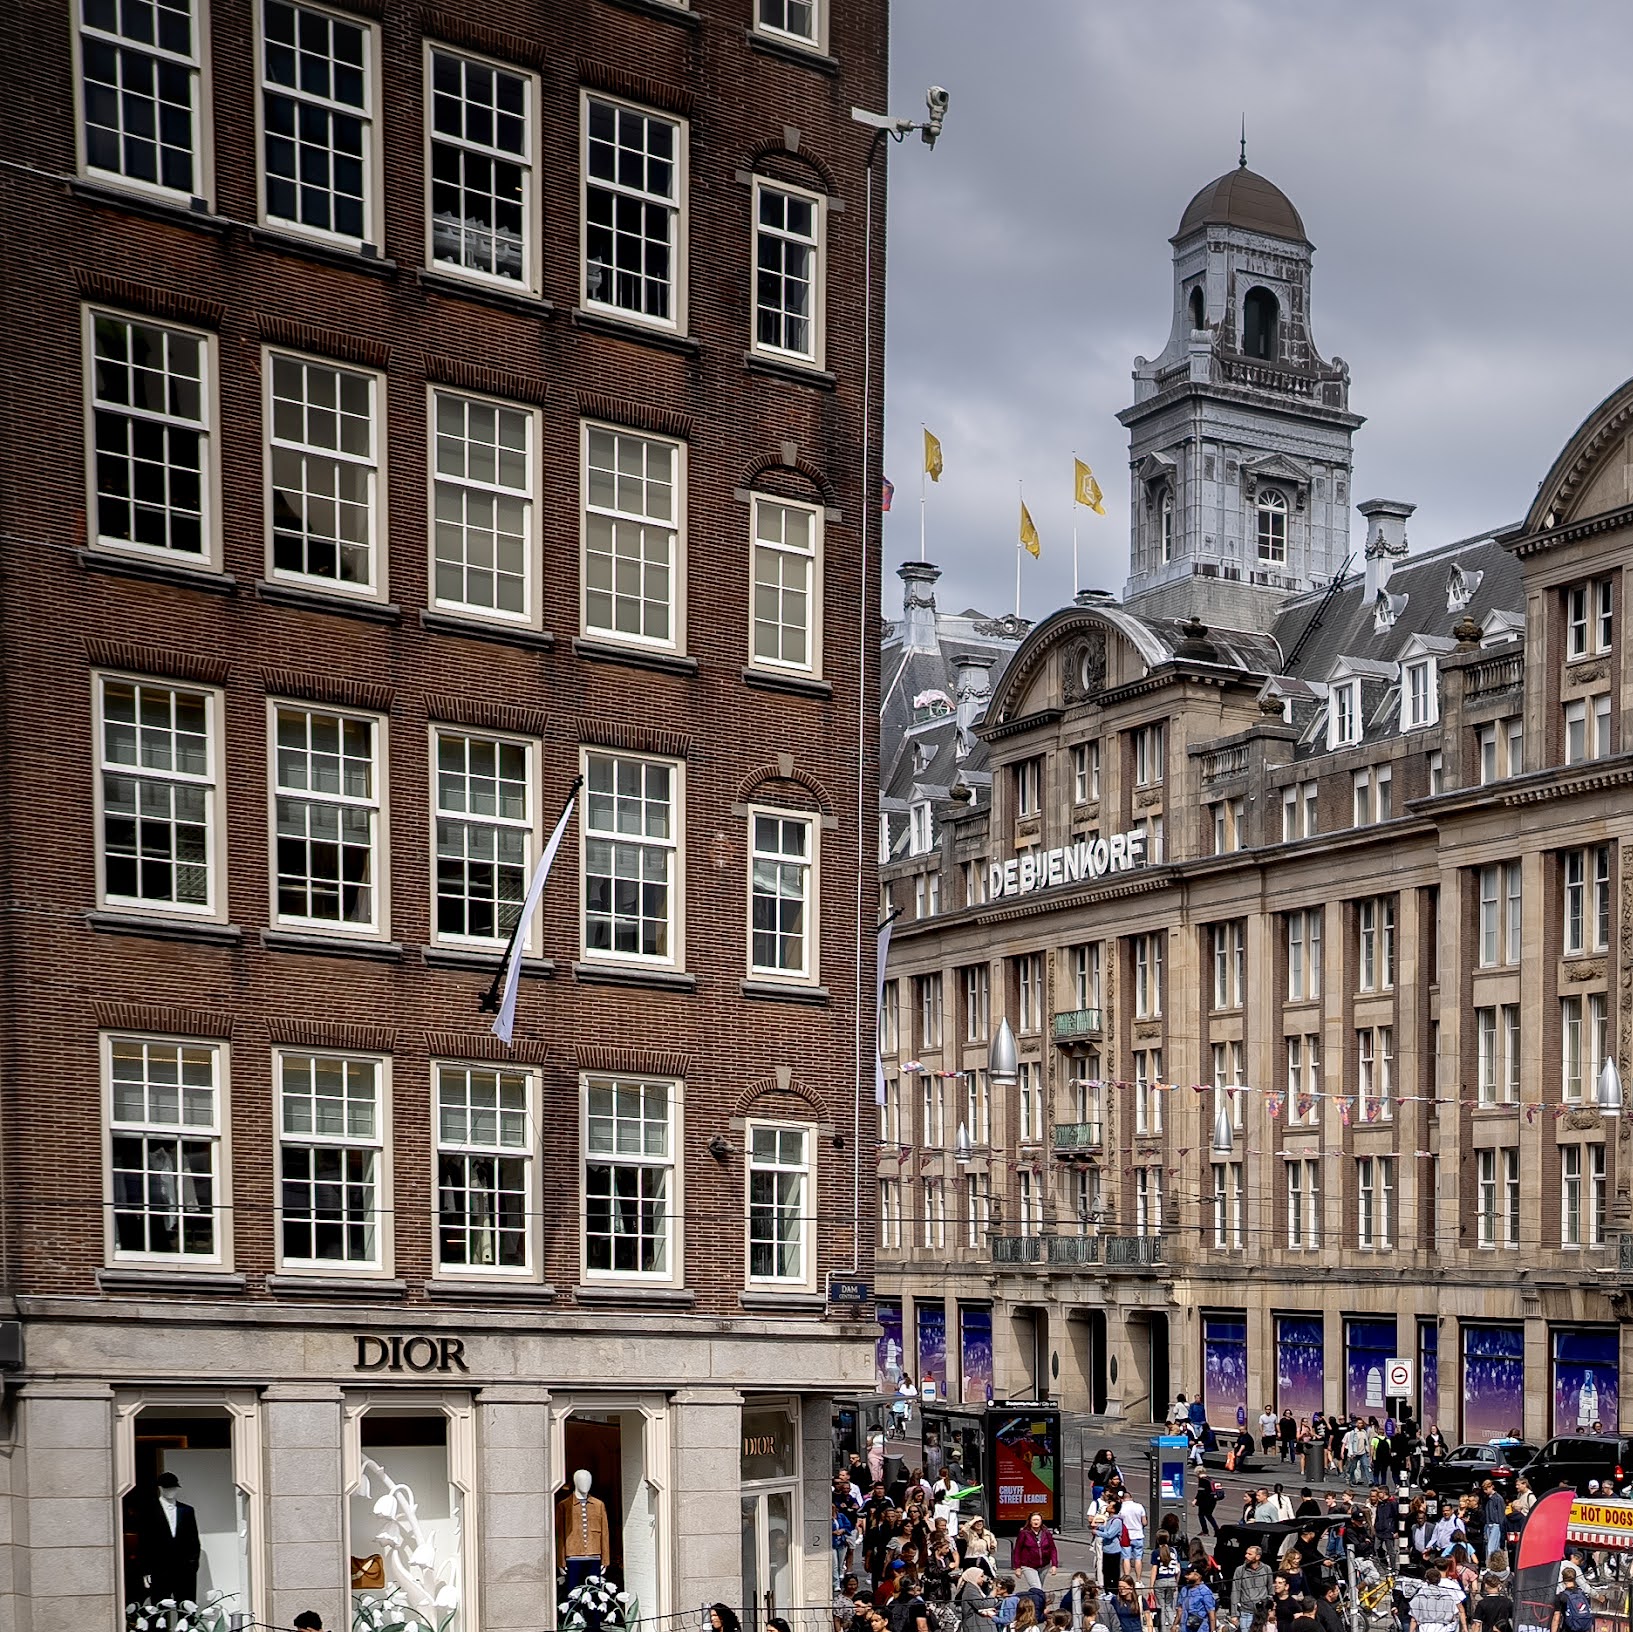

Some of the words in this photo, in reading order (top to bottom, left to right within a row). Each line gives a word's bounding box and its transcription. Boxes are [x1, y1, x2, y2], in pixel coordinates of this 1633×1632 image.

[989, 854, 1019, 899] DE
[1021, 828, 1147, 893] BIJENKORF
[842, 1285, 859, 1294] DAM
[353, 1335, 471, 1374] DIOR
[743, 1436, 777, 1456] DIOR
[998, 1485, 1025, 1495] CRUYFF
[998, 1494, 1022, 1505] STREET
[1023, 1494, 1048, 1504] LEAGUE
[1580, 1506, 1602, 1522] HOT
[1605, 1509, 1633, 1527] DOGS
[812, 1535, 821, 1547] 2
